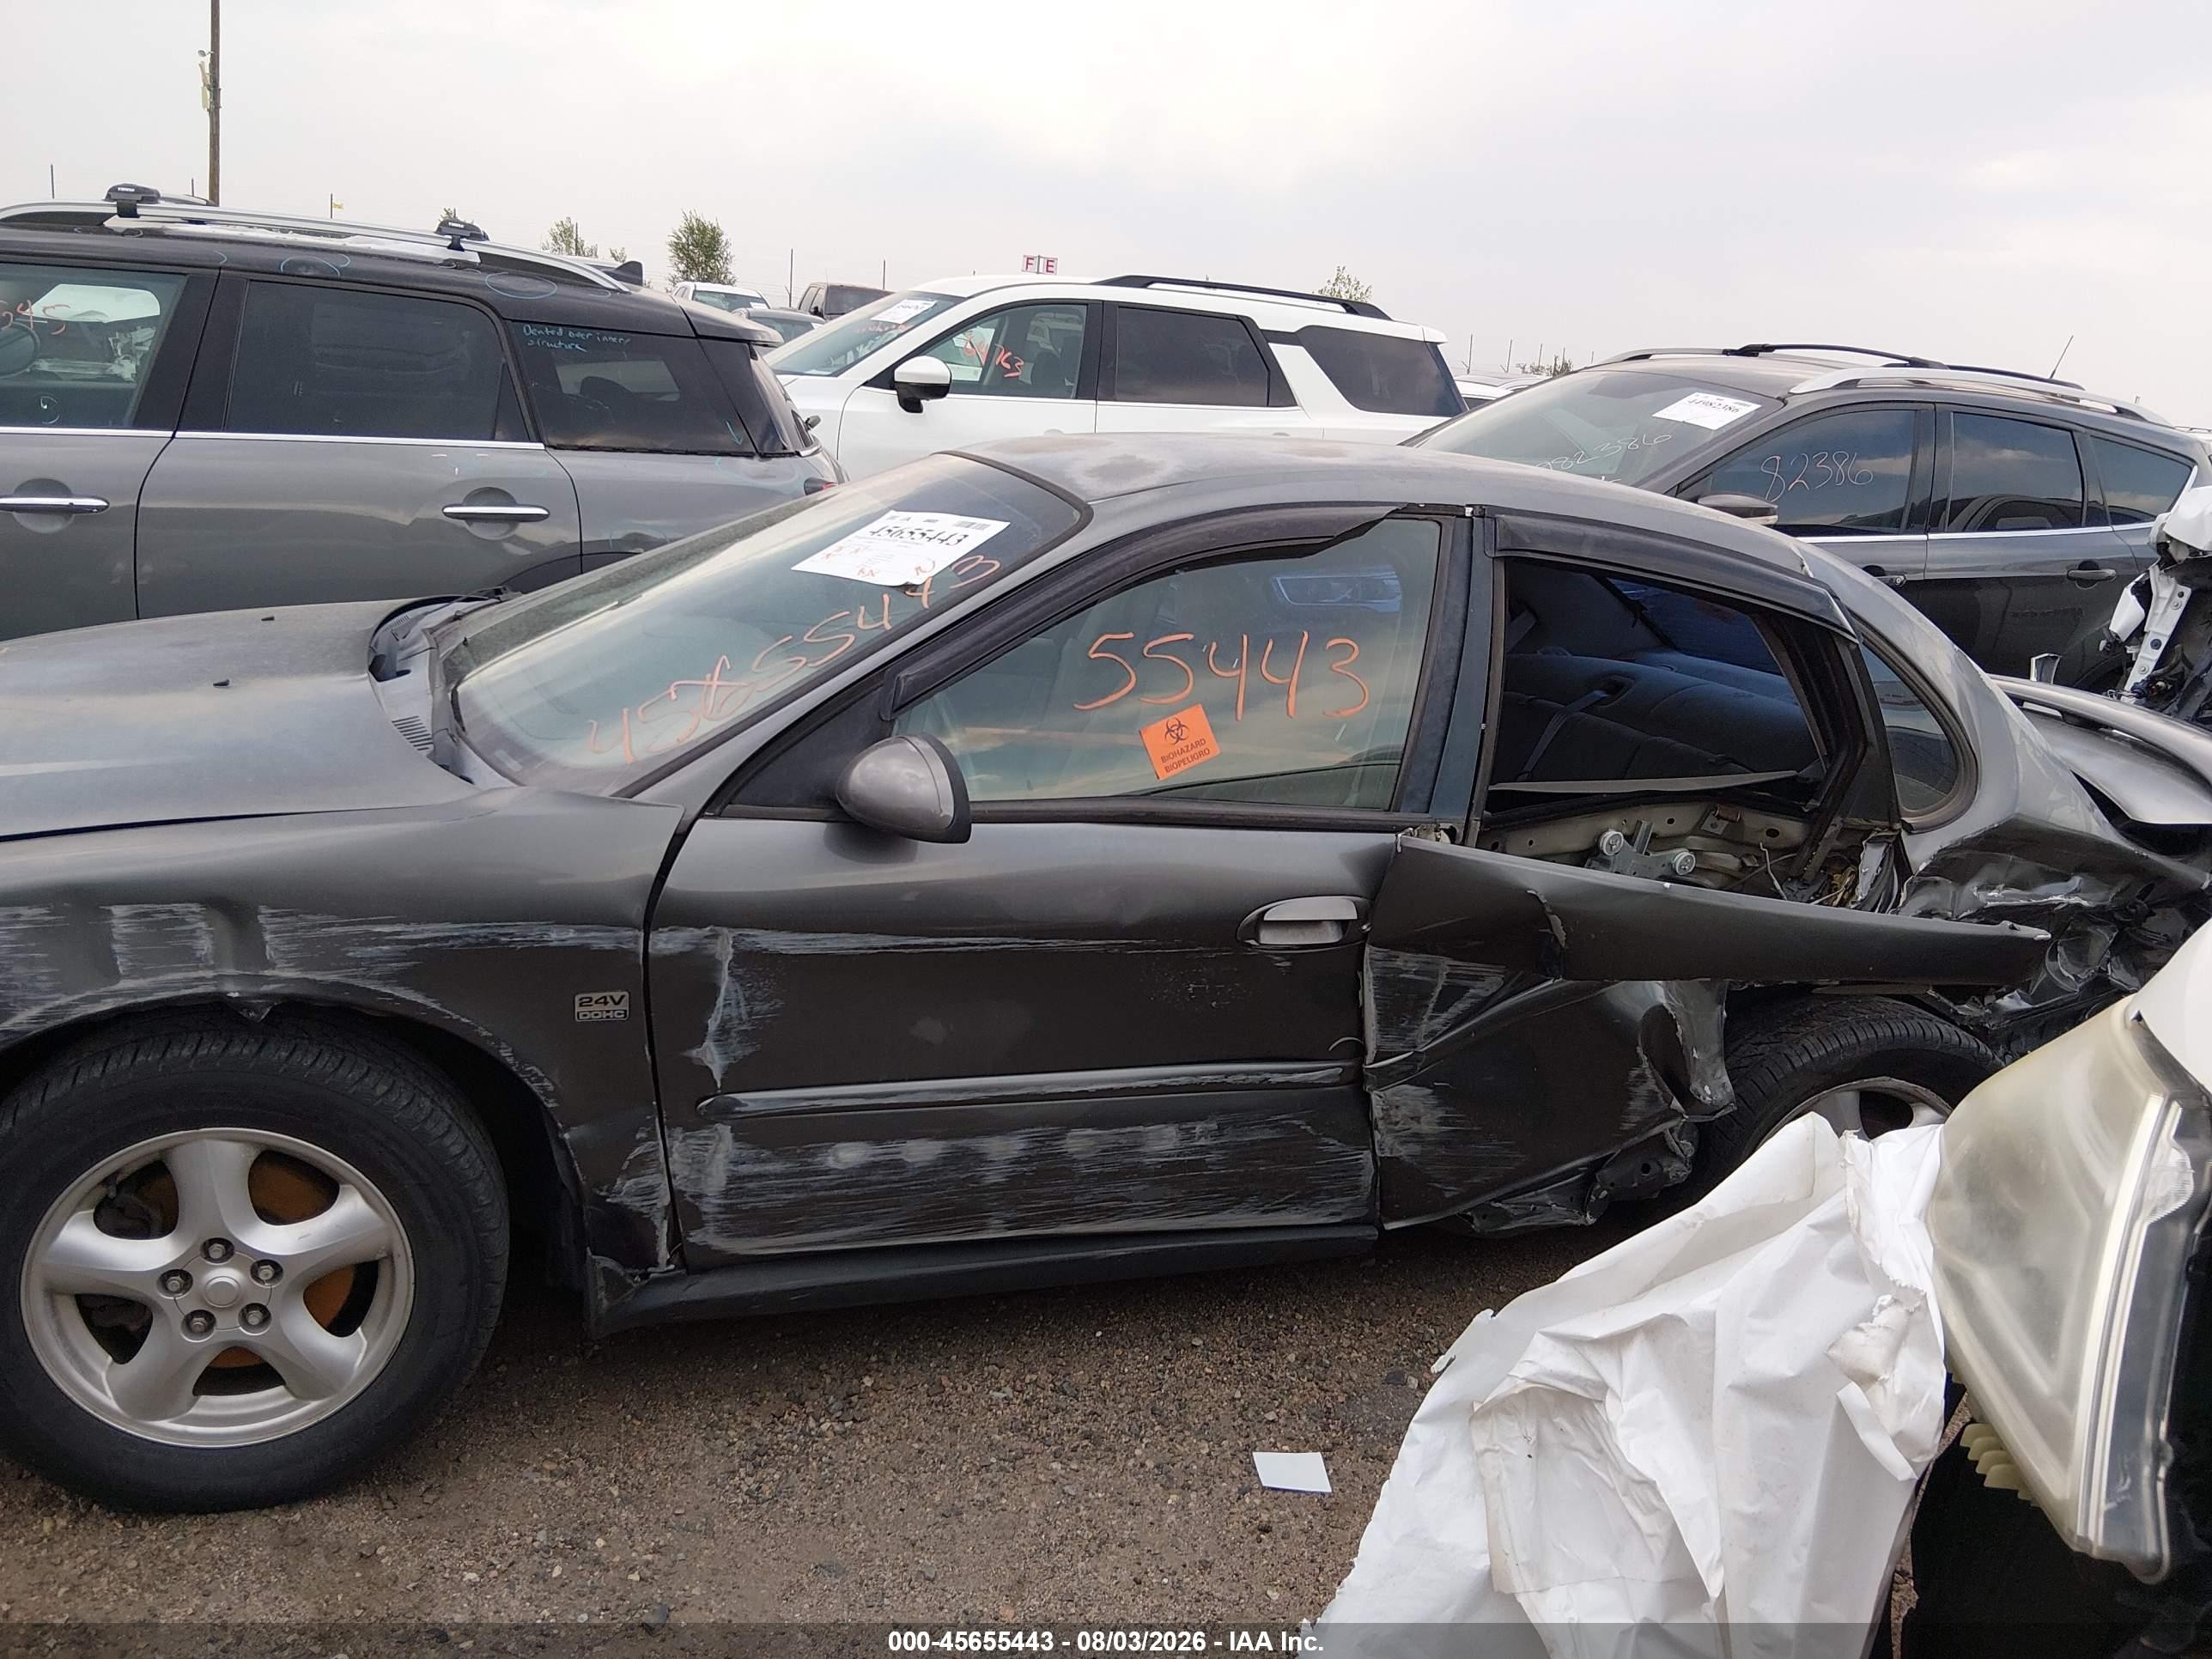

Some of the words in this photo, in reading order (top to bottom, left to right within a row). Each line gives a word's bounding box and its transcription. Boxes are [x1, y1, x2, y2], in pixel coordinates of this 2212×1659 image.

[1025, 257, 1035, 271] F
[1045, 259, 1054, 273] E
[1760, 451, 1874, 503] 82386
[1073, 630, 1370, 721] 55443
[1160, 738, 1206, 763] BIOHAZARD
[1164, 748, 1210, 774] BIOPELIGRO
[579, 994, 626, 1008] 24V
[578, 1010, 625, 1020] DOHC
